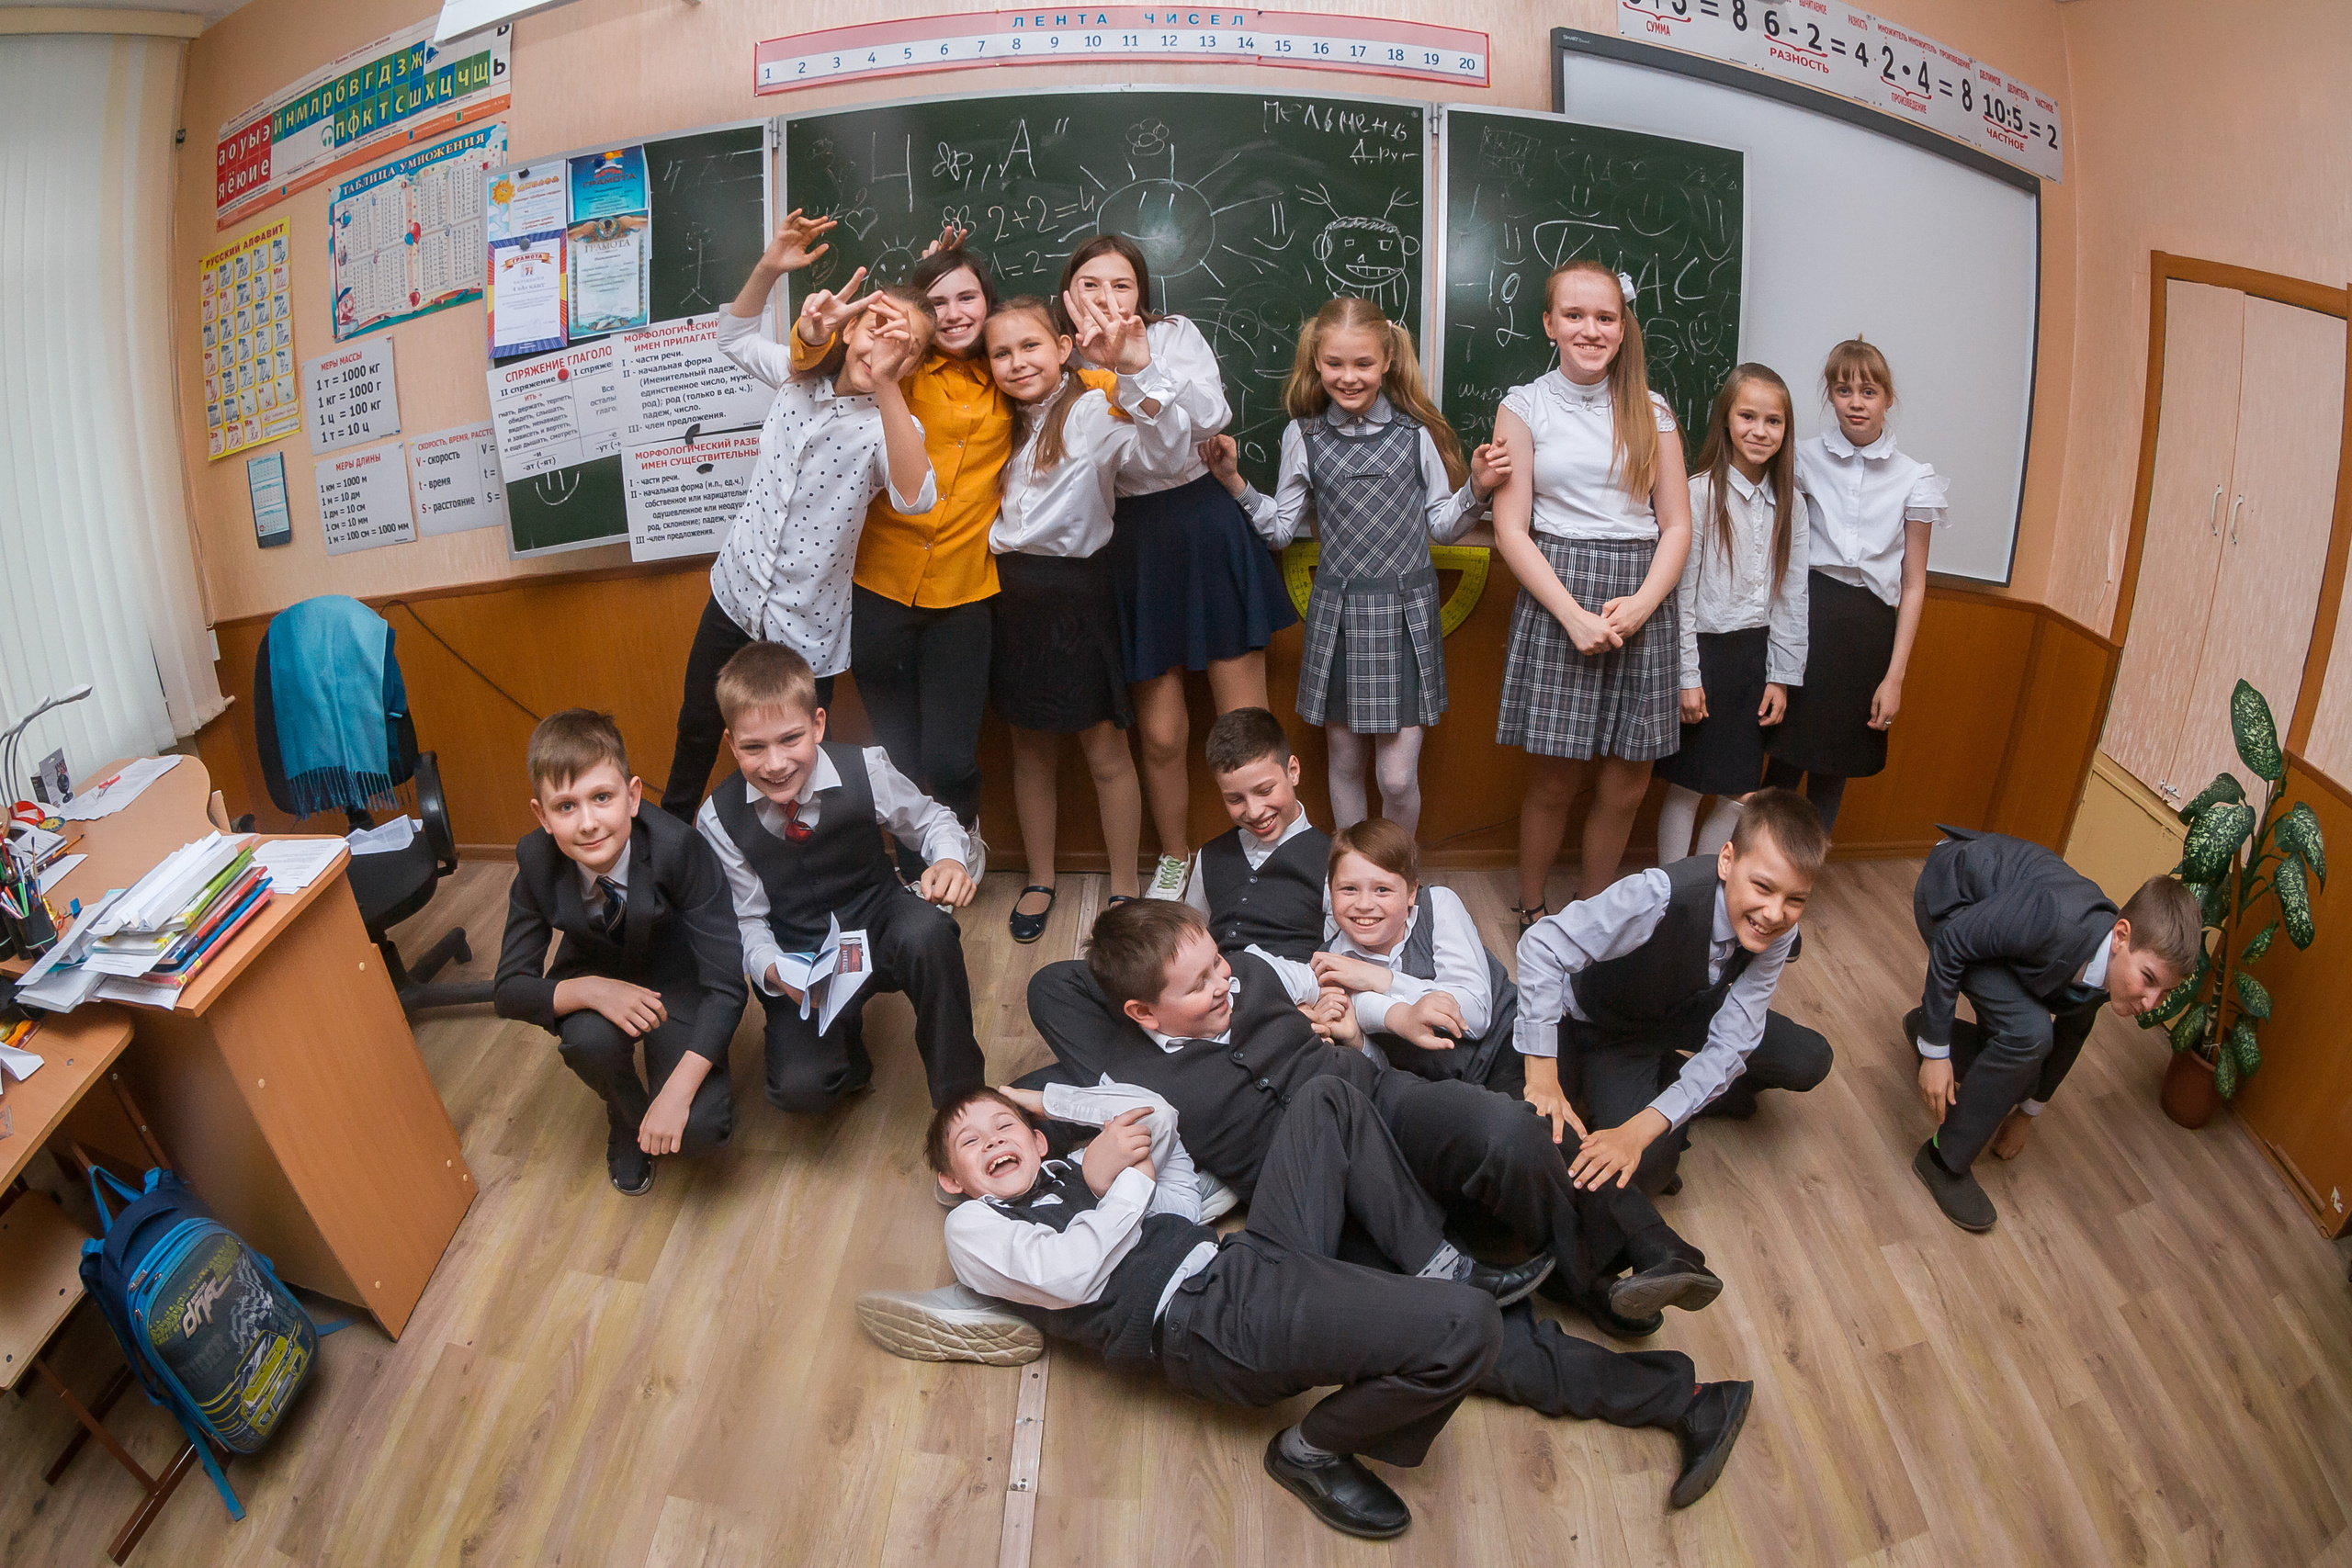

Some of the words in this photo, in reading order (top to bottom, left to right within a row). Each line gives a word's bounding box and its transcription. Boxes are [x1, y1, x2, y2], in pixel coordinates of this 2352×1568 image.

[1012, 14, 1108, 28] ЛЕНТА
[1145, 13, 1243, 26] ЧИСЕЛ
[1646, 21, 1670, 36] СУММА
[1849, 15, 1867, 30] РАЗНОСТЬ
[1878, 24, 1907, 42] МНОЖИТЕЛЬ
[1908, 36, 1937, 54] МНОЖИТЕЛЬ
[764, 68, 772, 79] 1
[798, 62, 806, 73] 2
[833, 57, 841, 68] 3
[868, 52, 876, 63] 4
[904, 48, 911, 59] 5
[940, 44, 948, 55] 6
[978, 40, 985, 52] 7
[1012, 38, 1021, 50] 8
[1050, 36, 1059, 48] 9
[1085, 36, 1102, 47] 10
[1123, 35, 1138, 47] 11
[1161, 35, 1178, 47] 12
[1200, 36, 1216, 47] 13
[1238, 37, 1254, 49] 14
[1275, 40, 1292, 52] 15
[1313, 42, 1329, 54] 16
[1351, 45, 1366, 57] 17
[1387, 49, 1404, 61] 18
[1424, 52, 1439, 65] 19
[1459, 58, 1475, 70] 20
[1770, 48, 1829, 73] РАЗНОСТЬ
[1855, 42, 1869, 68] 4
[1882, 46, 1895, 80] 2
[1917, 61, 1929, 94] 4
[1962, 78, 1973, 111] 8
[1980, 69, 2001, 87] ДЕЛИМОЕ
[2007, 83, 2029, 101] ДЕЛИТЕЛЬ
[2035, 96, 2054, 114] ЧАСТНОЕ
[1892, 93, 1927, 114] ПРОИЗВЕДЕНИЕ
[1986, 128, 2024, 152] ЧАСТНОЕ
[2047, 124, 2058, 150] 2
[343, 167, 395, 195] ТАБЛИЦА
[399, 133, 485, 172] УМНОЖЕНИЯ
[582, 174, 636, 188] ГРАМОТА
[206, 245, 240, 268] РУССКИЙ
[243, 224, 283, 250] АЛФАВИТ
[585, 239, 630, 253] ГРАМОТА
[513, 254, 542, 263] ГРАМОТА
[624, 319, 719, 343] МОРФОЛОГИЧЕСКИЙ
[634, 342, 661, 352] ИМЕН
[663, 332, 717, 347] ПРИЛАГАТЕ
[321, 359, 338, 371] МЕРЫ
[340, 351, 362, 366] МАССЫ
[505, 358, 564, 383] СПРЯЖЕНИЕ
[567, 345, 612, 367] ГЛАГОЛО
[636, 355, 659, 364] части
[662, 351, 683, 362] речи.
[639, 363, 682, 376] начальная
[684, 356, 712, 367] форма
[342, 366, 366, 383] 1000
[369, 363, 380, 374] кг
[639, 367, 707, 388] (Именительный
[708, 364, 738, 375] падеж,
[511, 376, 556, 393] спряжение
[640, 381, 699, 397] единственное
[700, 378, 728, 388] число,
[326, 395, 335, 406] кг
[349, 382, 373, 399] 1000
[642, 398, 662, 409] род);
[665, 397, 681, 405] род
[683, 389, 715, 402] (только
[350, 401, 368, 417] 100
[371, 400, 381, 412] кг
[518, 401, 545, 413] держать,
[547, 395, 572, 405] терпеть,
[643, 409, 672, 419] падеж,
[674, 404, 701, 413] число.
[508, 413, 534, 424] обидеть,
[536, 405, 564, 417] слышать,
[645, 422, 664, 430] член
[667, 412, 726, 426] предложения.
[348, 423, 359, 436] 10
[513, 430, 539, 442] зависеть
[547, 422, 571, 432] вертеть,
[418, 439, 447, 451] СКОРОСТЬ,
[449, 434, 469, 444] ВРЕМЯ,
[470, 428, 493, 440] РАССТО
[524, 436, 548, 448] дышать,
[428, 452, 460, 465] скорость
[635, 439, 730, 460] МОРФОЛОГИЧЕСКИЙ
[336, 460, 354, 471] МЕРЫ
[356, 454, 381, 468] ДЛИНЫ
[641, 460, 667, 470] ИМЕН
[671, 448, 759, 466] СУЩЕСТВИТЕЛЬНЫ
[326, 483, 335, 491] км
[344, 477, 360, 488] 1000
[428, 478, 451, 490] время
[641, 476, 661, 485] части
[662, 474, 680, 483] речи.
[341, 492, 349, 502] 10
[351, 491, 360, 501] дм
[643, 487, 679, 497] начальная
[681, 484, 703, 493] форма
[329, 508, 339, 519] дм
[345, 504, 355, 514] 10
[356, 503, 366, 512] см
[433, 497, 475, 513] расстояние
[645, 496, 686, 508] собственное
[653, 506, 702, 519] одушевленное
[332, 522, 340, 530] см
[348, 517, 356, 526] 10
[358, 516, 368, 525] мм
[347, 529, 359, 540] 100
[361, 528, 369, 537] см
[379, 524, 396, 535] 1000
[398, 523, 409, 531] мм
[663, 519, 700, 529] склонение;
[667, 530, 715, 541] предложения.
